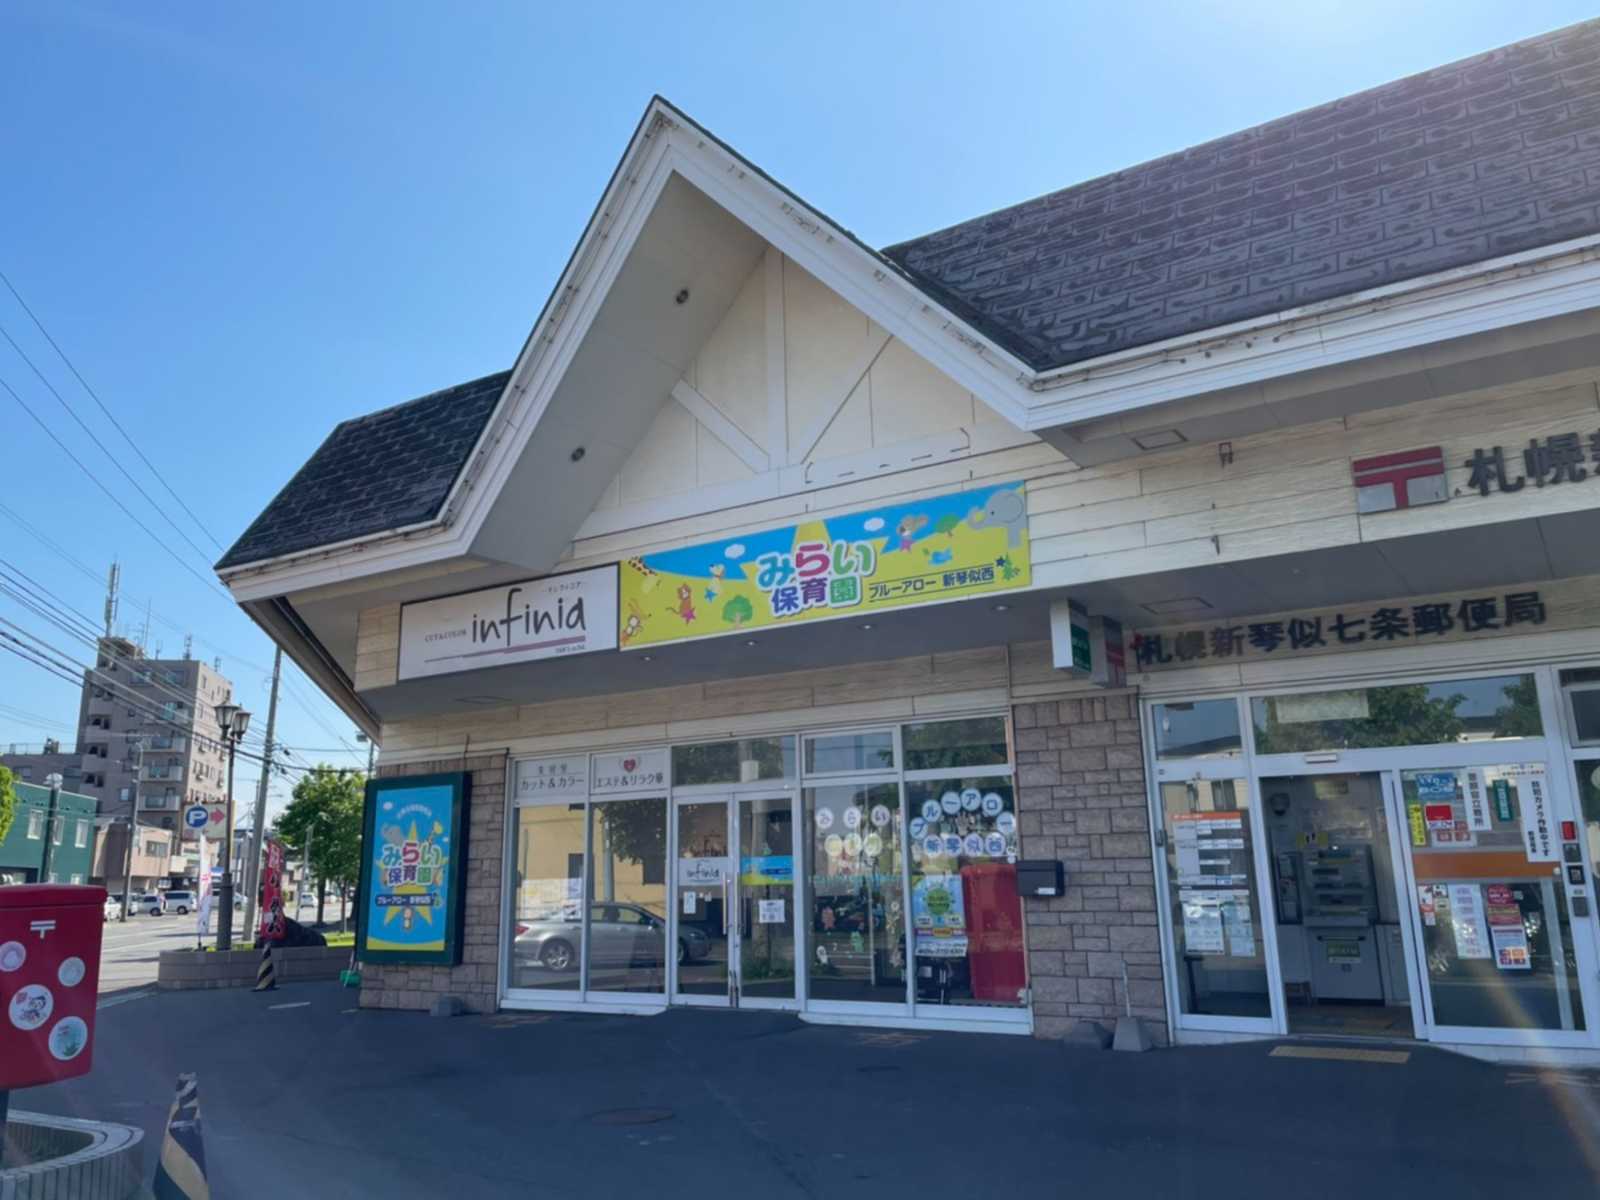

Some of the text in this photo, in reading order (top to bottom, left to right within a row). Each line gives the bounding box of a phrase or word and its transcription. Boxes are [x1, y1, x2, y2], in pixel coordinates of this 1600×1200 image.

[757, 543, 873, 588] みらい
[869, 566, 995, 598] ブルーアロー 新琴似西
[772, 576, 857, 612] 保育園
[1136, 591, 1547, 665] 札幌新琴似七条郵便局
[382, 842, 441, 866] みらい
[388, 864, 432, 884] 保育園
